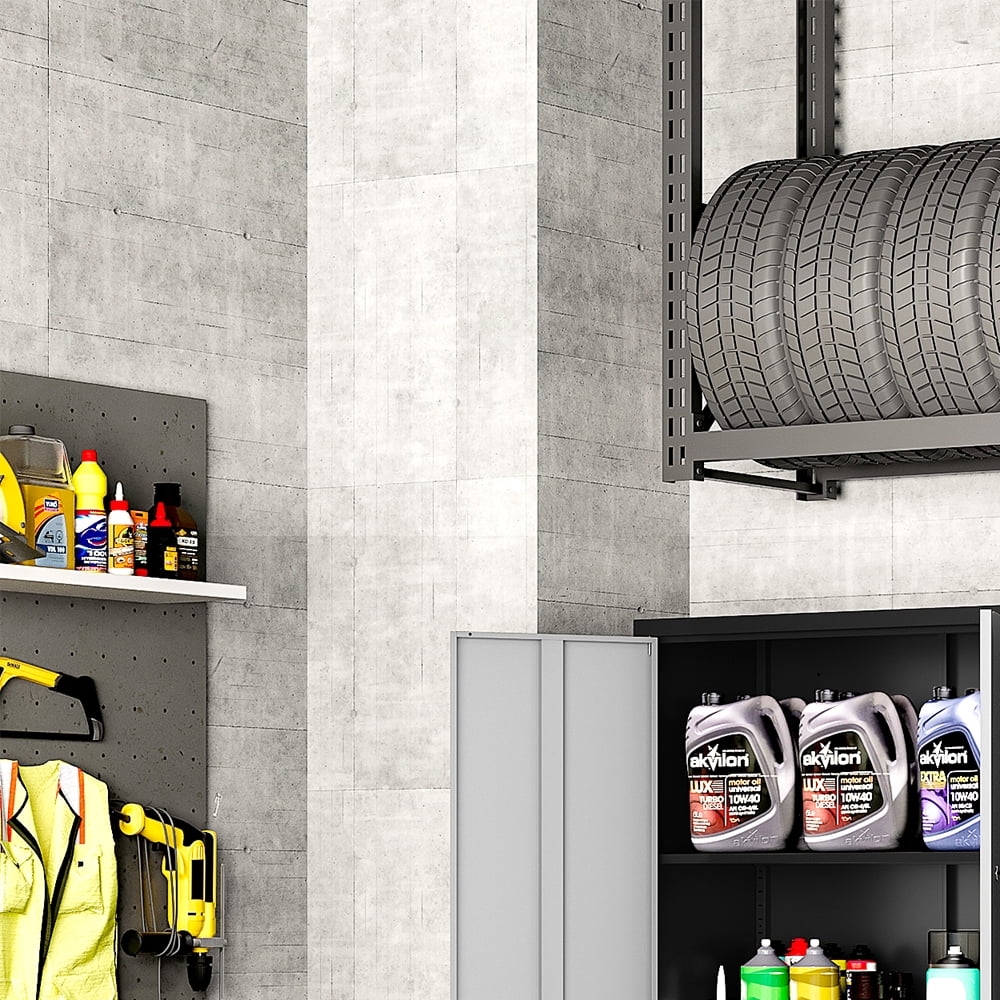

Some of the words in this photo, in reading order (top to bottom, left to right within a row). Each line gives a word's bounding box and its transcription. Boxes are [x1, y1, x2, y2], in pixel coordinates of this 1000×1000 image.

[690, 745, 750, 771] akvilon
[803, 743, 862, 769] akvilon
[919, 743, 968, 768] akvilon
[728, 778, 750, 786] motor
[751, 778, 762, 786] oil
[840, 776, 862, 784] motor
[920, 770, 947, 783] EXTRA
[969, 775, 979, 783] oil
[689, 779, 713, 793] LUX
[803, 777, 826, 791] LUX
[728, 793, 761, 804] 10W40
[840, 792, 873, 803] 10W40
[950, 791, 979, 802] 10W40
